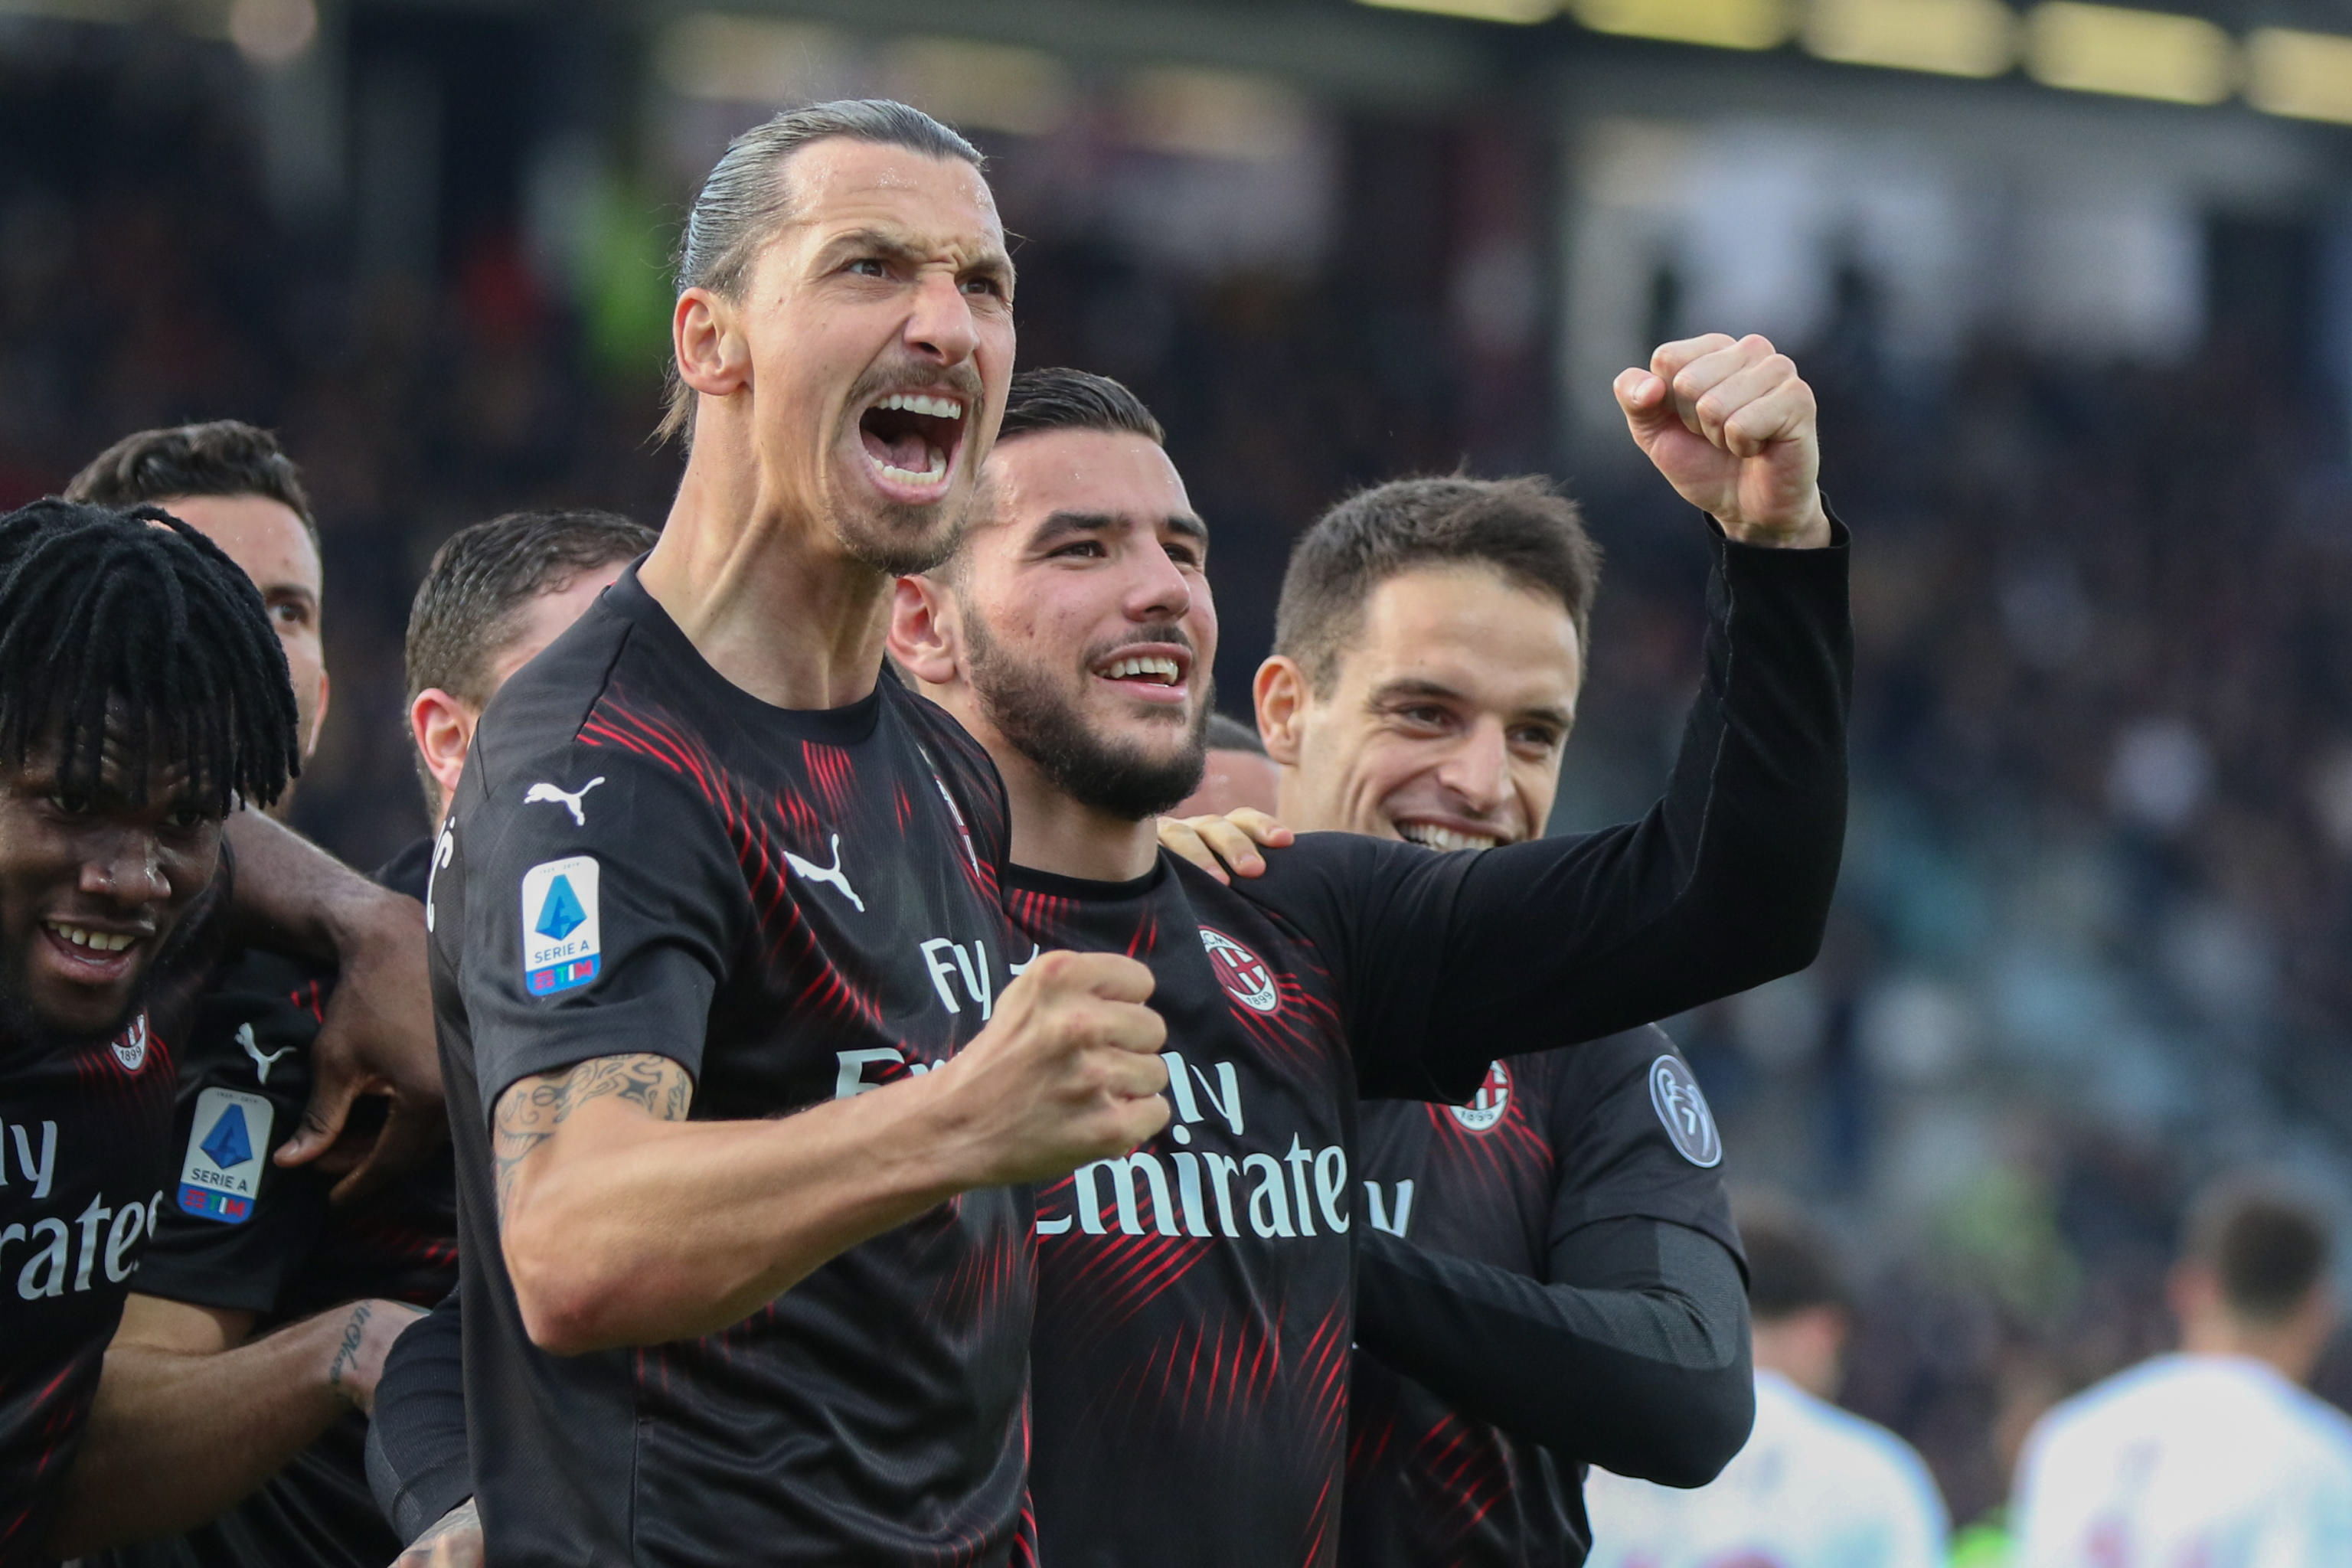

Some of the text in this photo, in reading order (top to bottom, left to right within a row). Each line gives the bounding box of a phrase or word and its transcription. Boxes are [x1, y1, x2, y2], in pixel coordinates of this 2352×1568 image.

[534, 939, 590, 963] SERIE A
[555, 959, 593, 983] TIM
[920, 937, 992, 1021] Fy
[1246, 991, 1273, 1005] 1899
[120, 1046, 142, 1061] 1899
[1161, 1050, 1244, 1136] ly
[191, 1168, 248, 1192] SERIE A
[1037, 1124, 1351, 1239] mirate
[208, 1194, 246, 1217] TIM
